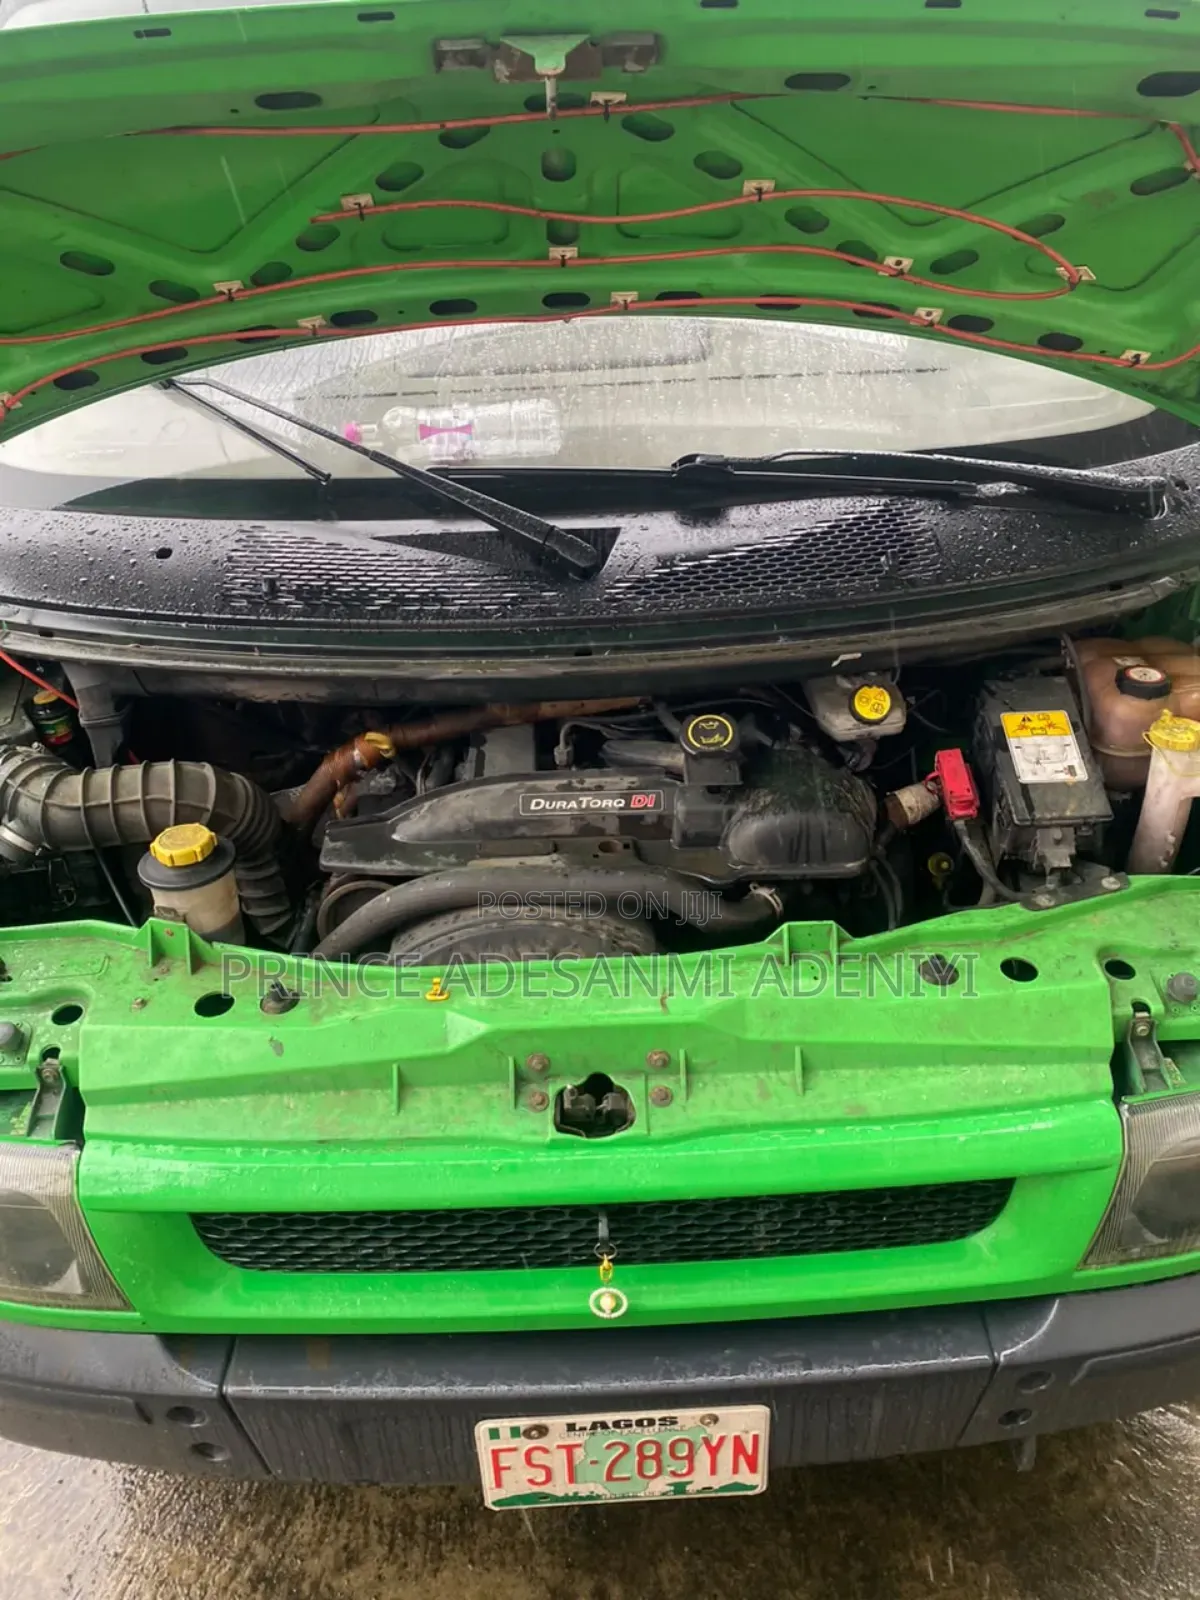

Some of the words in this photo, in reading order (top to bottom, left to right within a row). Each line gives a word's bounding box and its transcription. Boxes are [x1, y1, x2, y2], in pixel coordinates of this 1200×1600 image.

[630, 794, 656, 809] DI
[565, 1416, 679, 1432] LAGOS
[489, 1434, 760, 1489] FST-289YN
